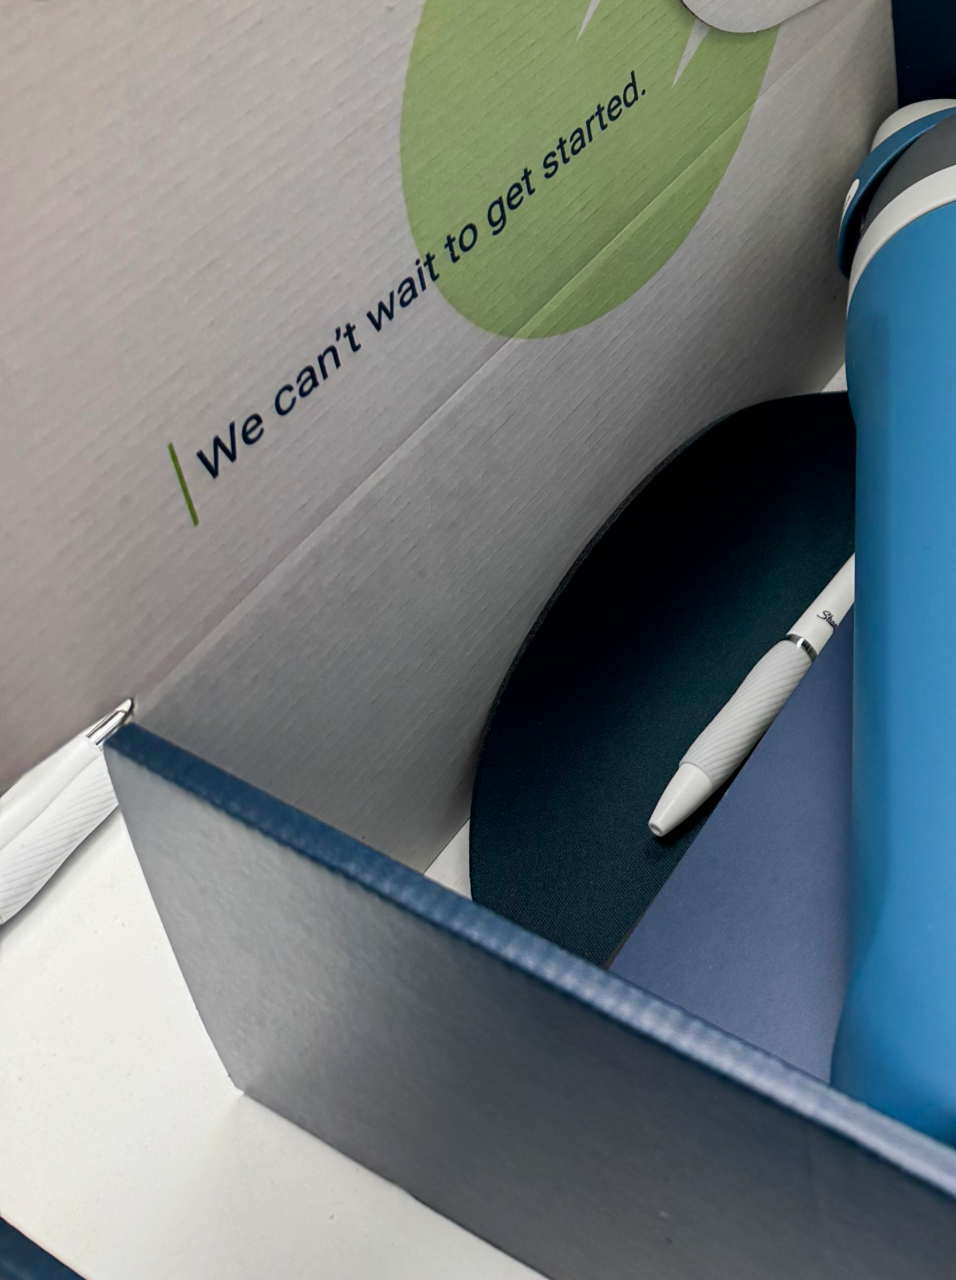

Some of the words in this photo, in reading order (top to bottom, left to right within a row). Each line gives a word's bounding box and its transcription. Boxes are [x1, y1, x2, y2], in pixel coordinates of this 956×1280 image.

[196, 413, 265, 481] We
[365, 253, 440, 333] wait
[443, 222, 478, 265] to
[486, 167, 537, 236] get
[542, 70, 647, 180] started.
